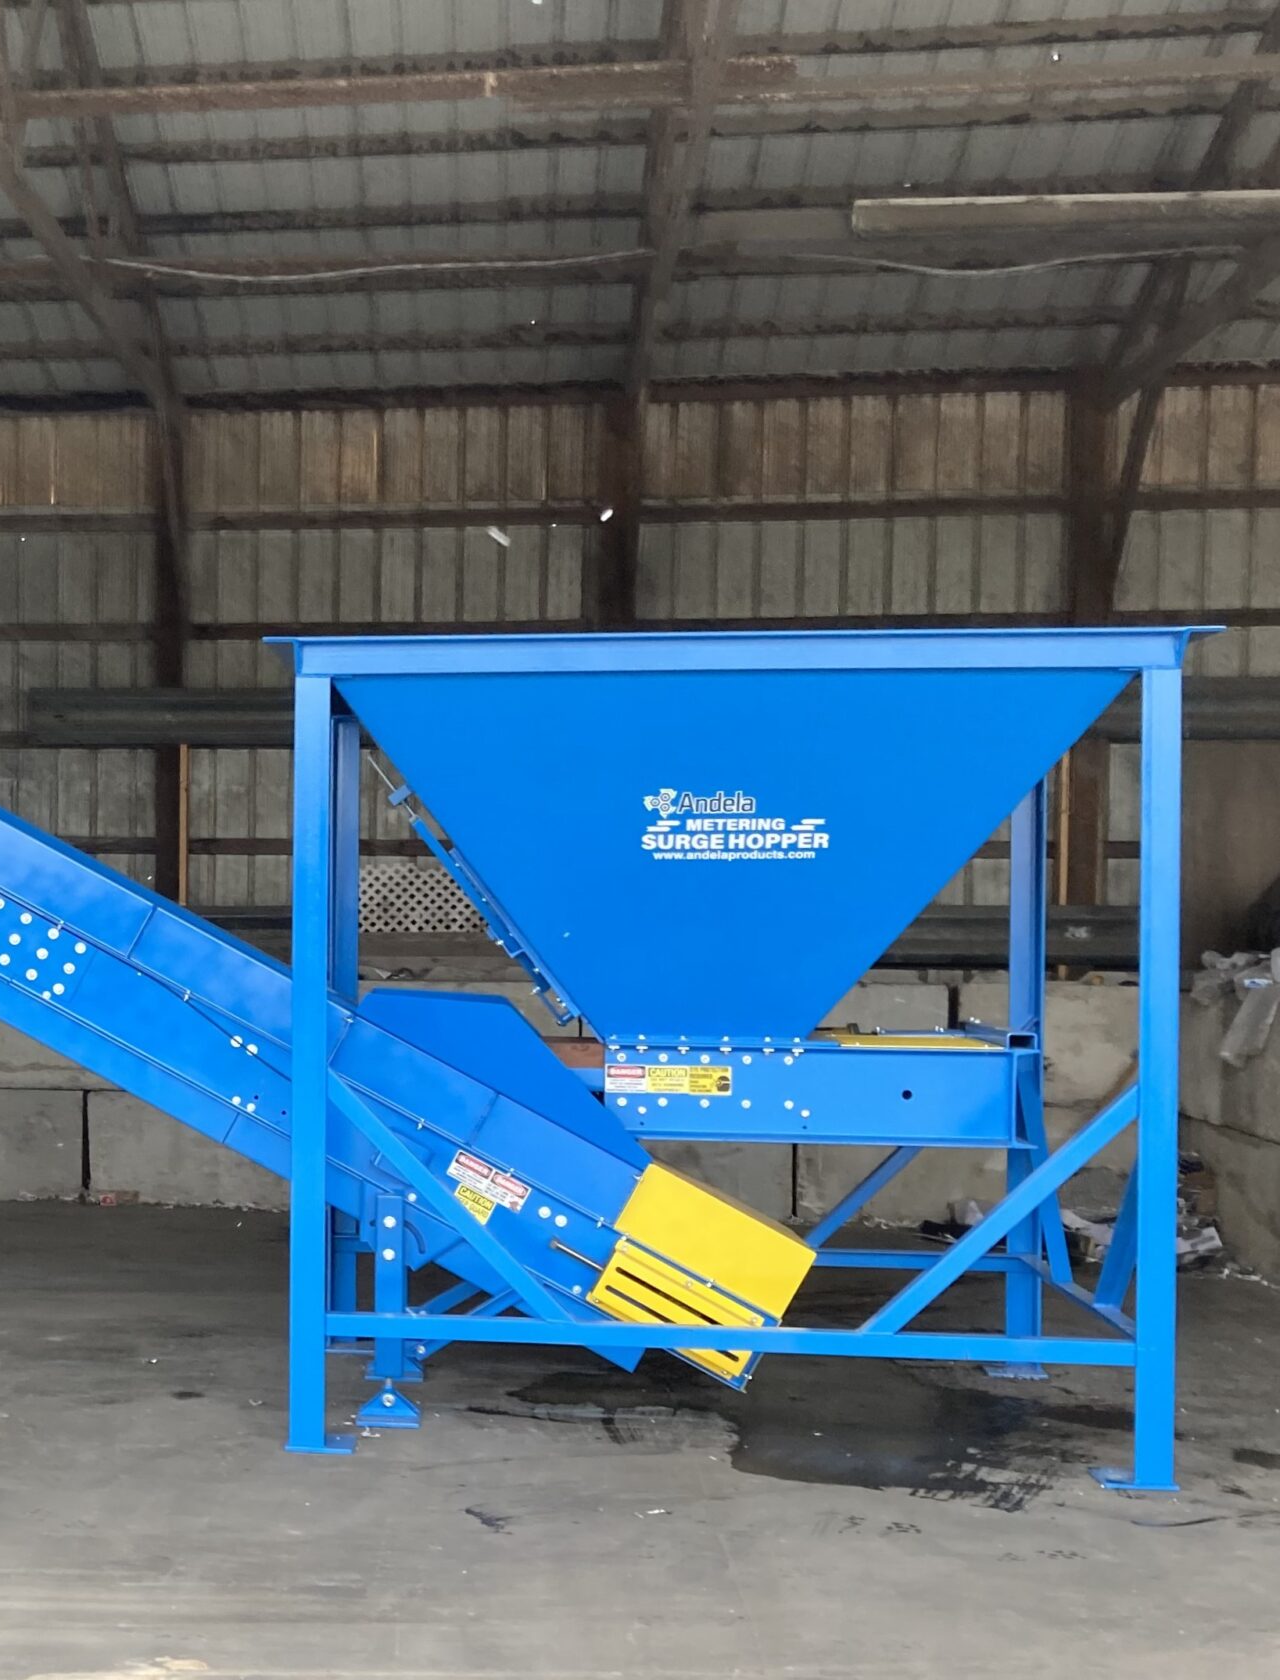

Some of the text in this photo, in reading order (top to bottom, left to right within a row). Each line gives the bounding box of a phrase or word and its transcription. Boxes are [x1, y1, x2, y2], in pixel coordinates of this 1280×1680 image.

[677, 791, 755, 814] Andela
[686, 818, 785, 831] METERING
[641, 833, 830, 850] SURGE HOPPER
[653, 850, 816, 861] www.andelaproducts.com
[649, 1067, 687, 1077] CAUTION
[459, 1186, 493, 1210] CAUTION
